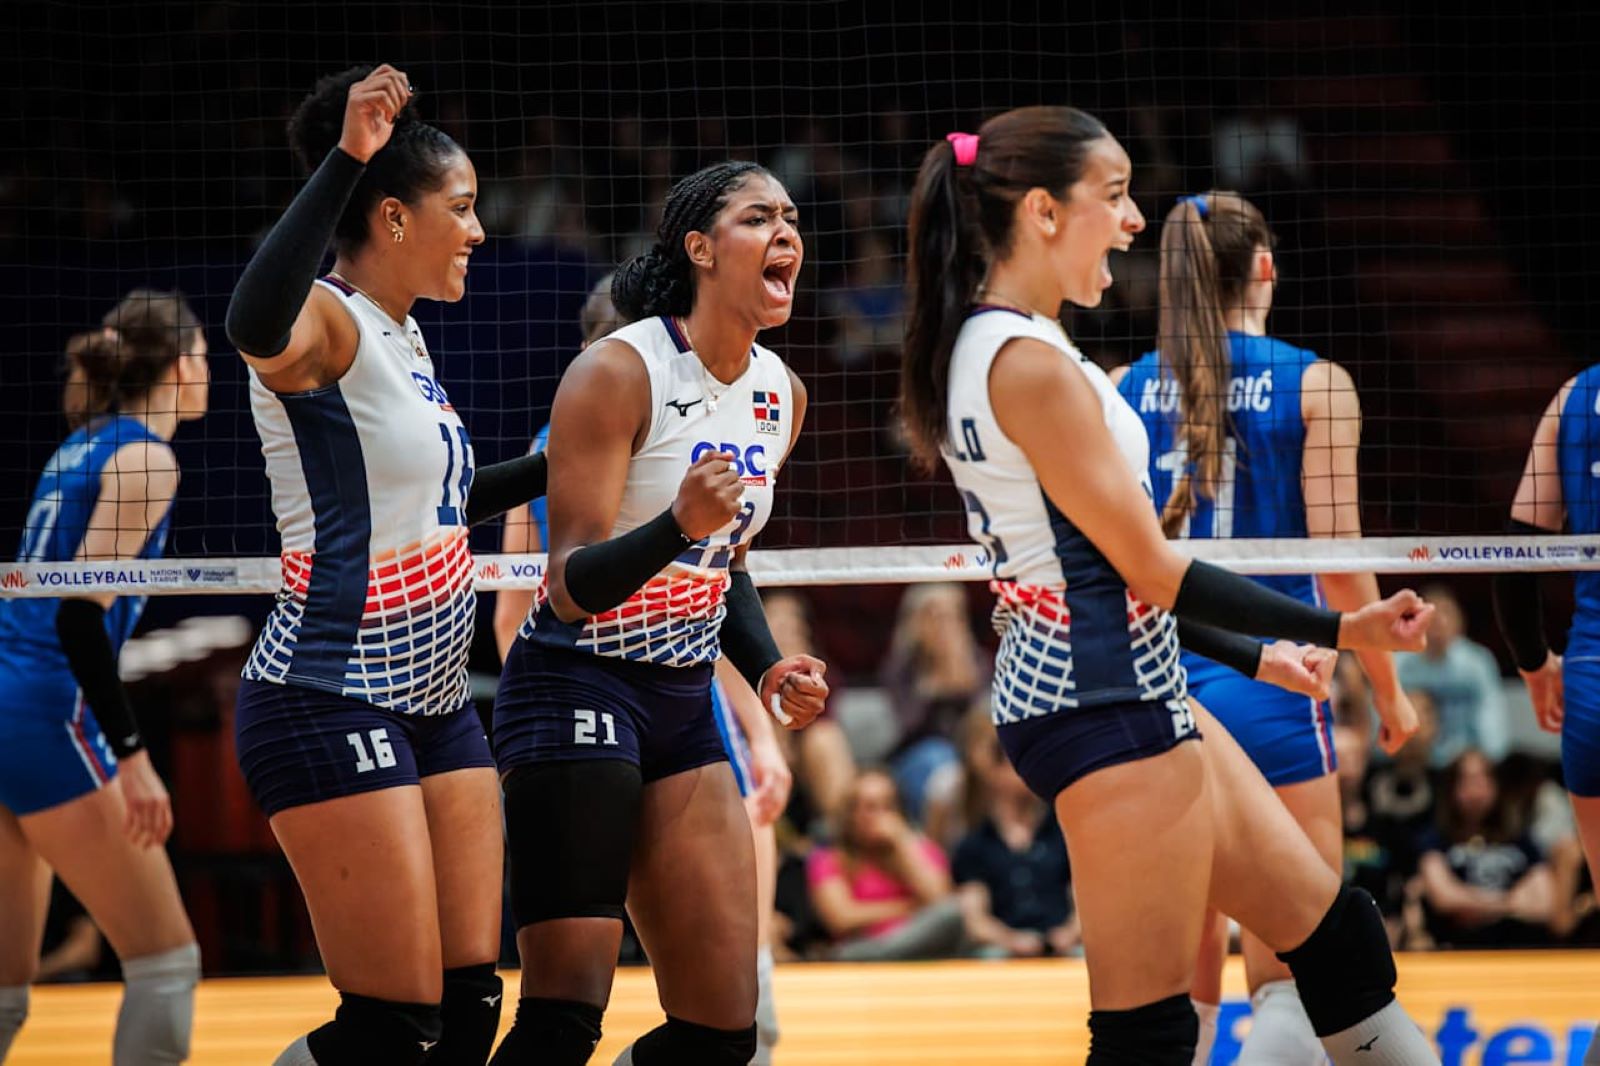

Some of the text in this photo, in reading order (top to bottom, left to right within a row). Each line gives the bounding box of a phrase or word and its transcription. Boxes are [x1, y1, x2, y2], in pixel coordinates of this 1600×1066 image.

[1140, 369, 1273, 414] KUGIĆ
[760, 421, 777, 432] DOM
[1439, 546, 1544, 560] VOLLEYBALL
[37, 569, 147, 586] VOLLEYBALL
[574, 709, 619, 746] 21
[346, 728, 397, 773] 16
